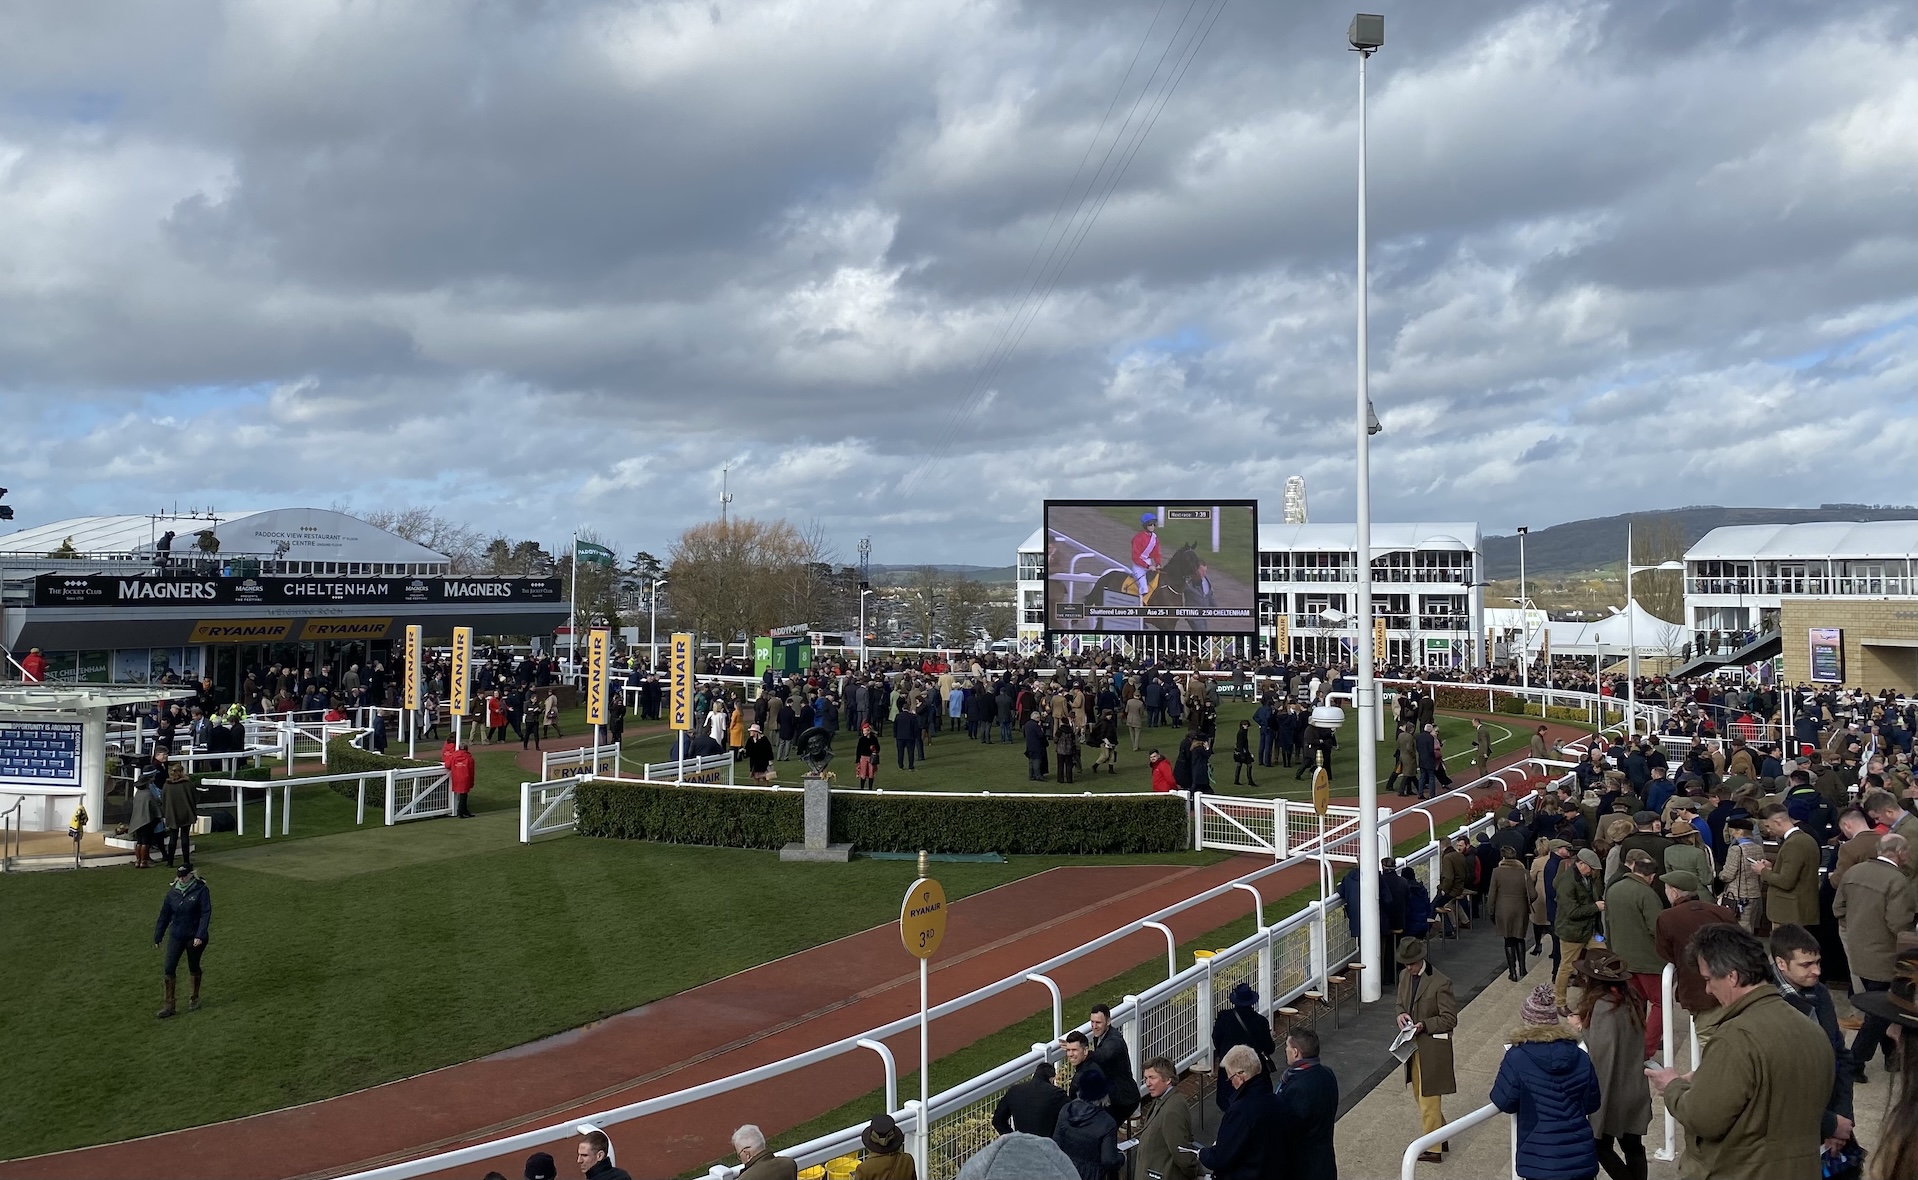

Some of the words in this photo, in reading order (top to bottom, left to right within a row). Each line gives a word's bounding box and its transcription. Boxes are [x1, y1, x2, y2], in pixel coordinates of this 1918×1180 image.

[118, 580, 218, 599] MAGNERS
[283, 583, 389, 596] CHELTENHAM
[443, 581, 513, 597] MAGNERS
[208, 625, 286, 636] RYANAIR
[316, 623, 386, 634] RYANAIR
[776, 653, 783, 664] 7
[802, 651, 808, 662] 8
[59, 664, 107, 677] CHELTENHAM
[407, 630, 415, 705] RYANAIR
[453, 633, 465, 711] RYANAIR
[590, 636, 603, 720] RYANAIR
[674, 640, 687, 725] RYANAIR
[12, 722, 44, 731] OPPORTUNITY
[44, 723, 51, 731] IS
[50, 723, 71, 732] AROUND
[71, 724, 81, 732] THE
[562, 762, 609, 779] RYANIR
[682, 771, 720, 785] YANAIR
[910, 902, 941, 918] RYANAIR
[919, 928, 935, 948] 3RD
